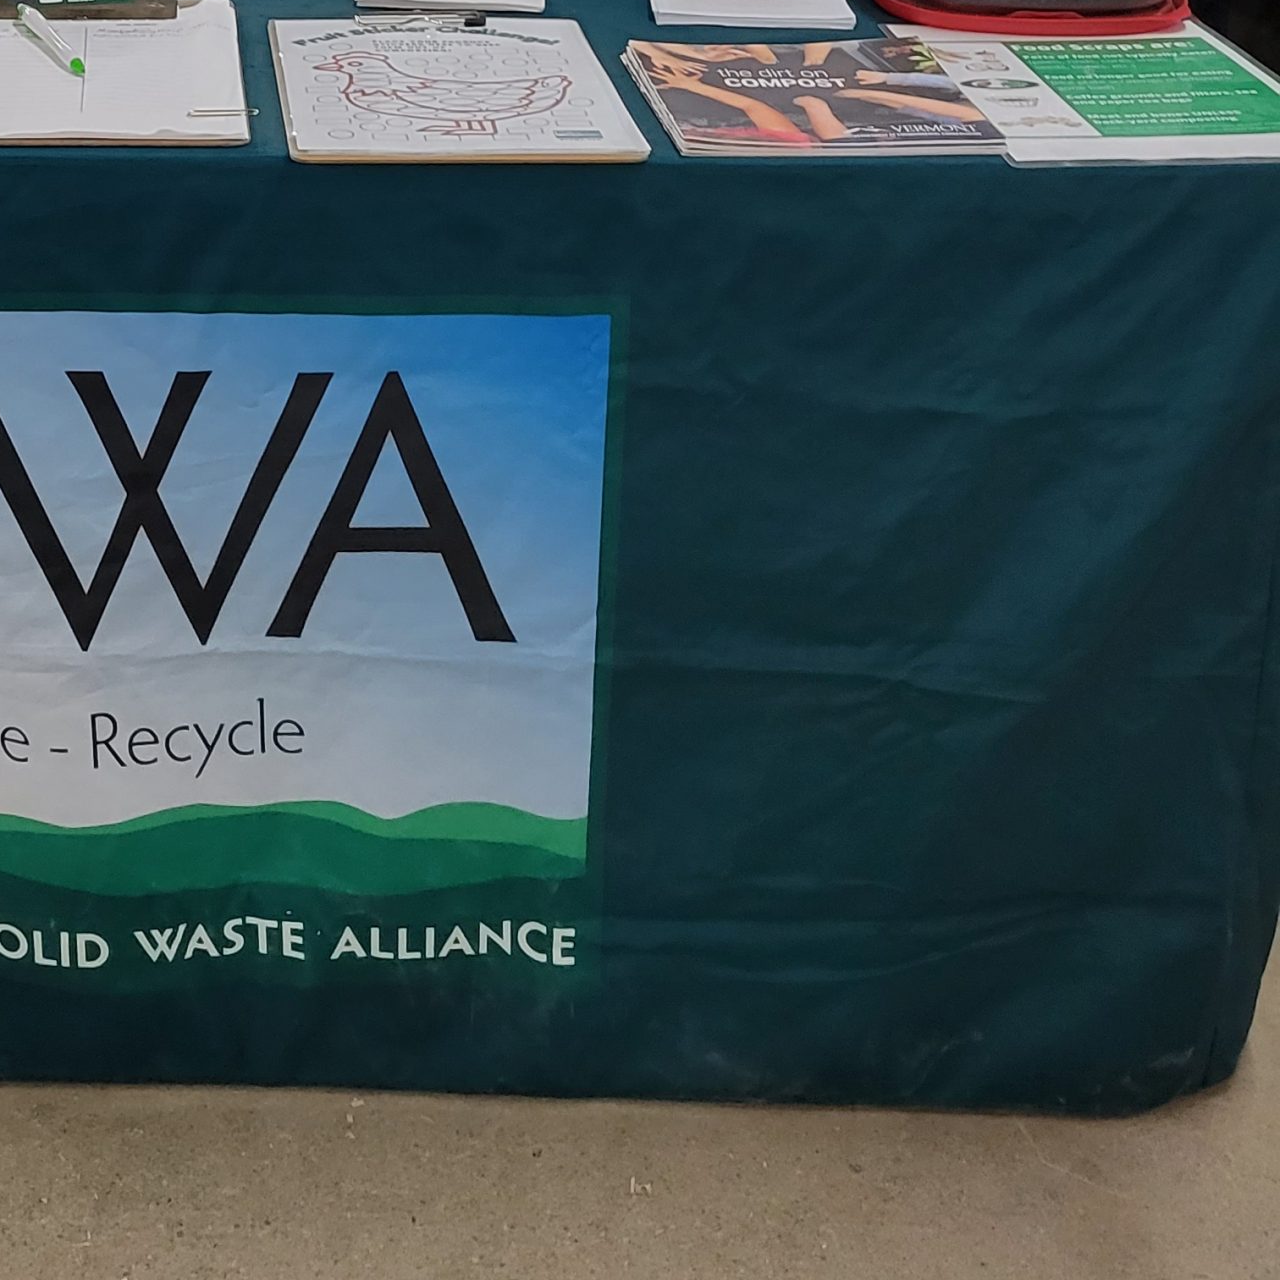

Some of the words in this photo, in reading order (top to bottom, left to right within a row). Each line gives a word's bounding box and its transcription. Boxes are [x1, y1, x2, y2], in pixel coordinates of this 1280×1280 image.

[293, 32, 348, 47] Fruit
[348, 26, 430, 37] Sticker
[435, 26, 560, 46] Challenge!
[1010, 44, 1066, 52] Food
[1069, 43, 1145, 52] Scraps
[717, 67, 754, 78] the
[756, 67, 797, 78] dirt
[800, 69, 829, 78] on
[723, 77, 846, 88] COMPOST
[889, 124, 977, 133] VERMONT
[90, 697, 307, 778] Recycle
[133, 915, 306, 962] WASTE
[330, 919, 577, 967] ALLIANCE
